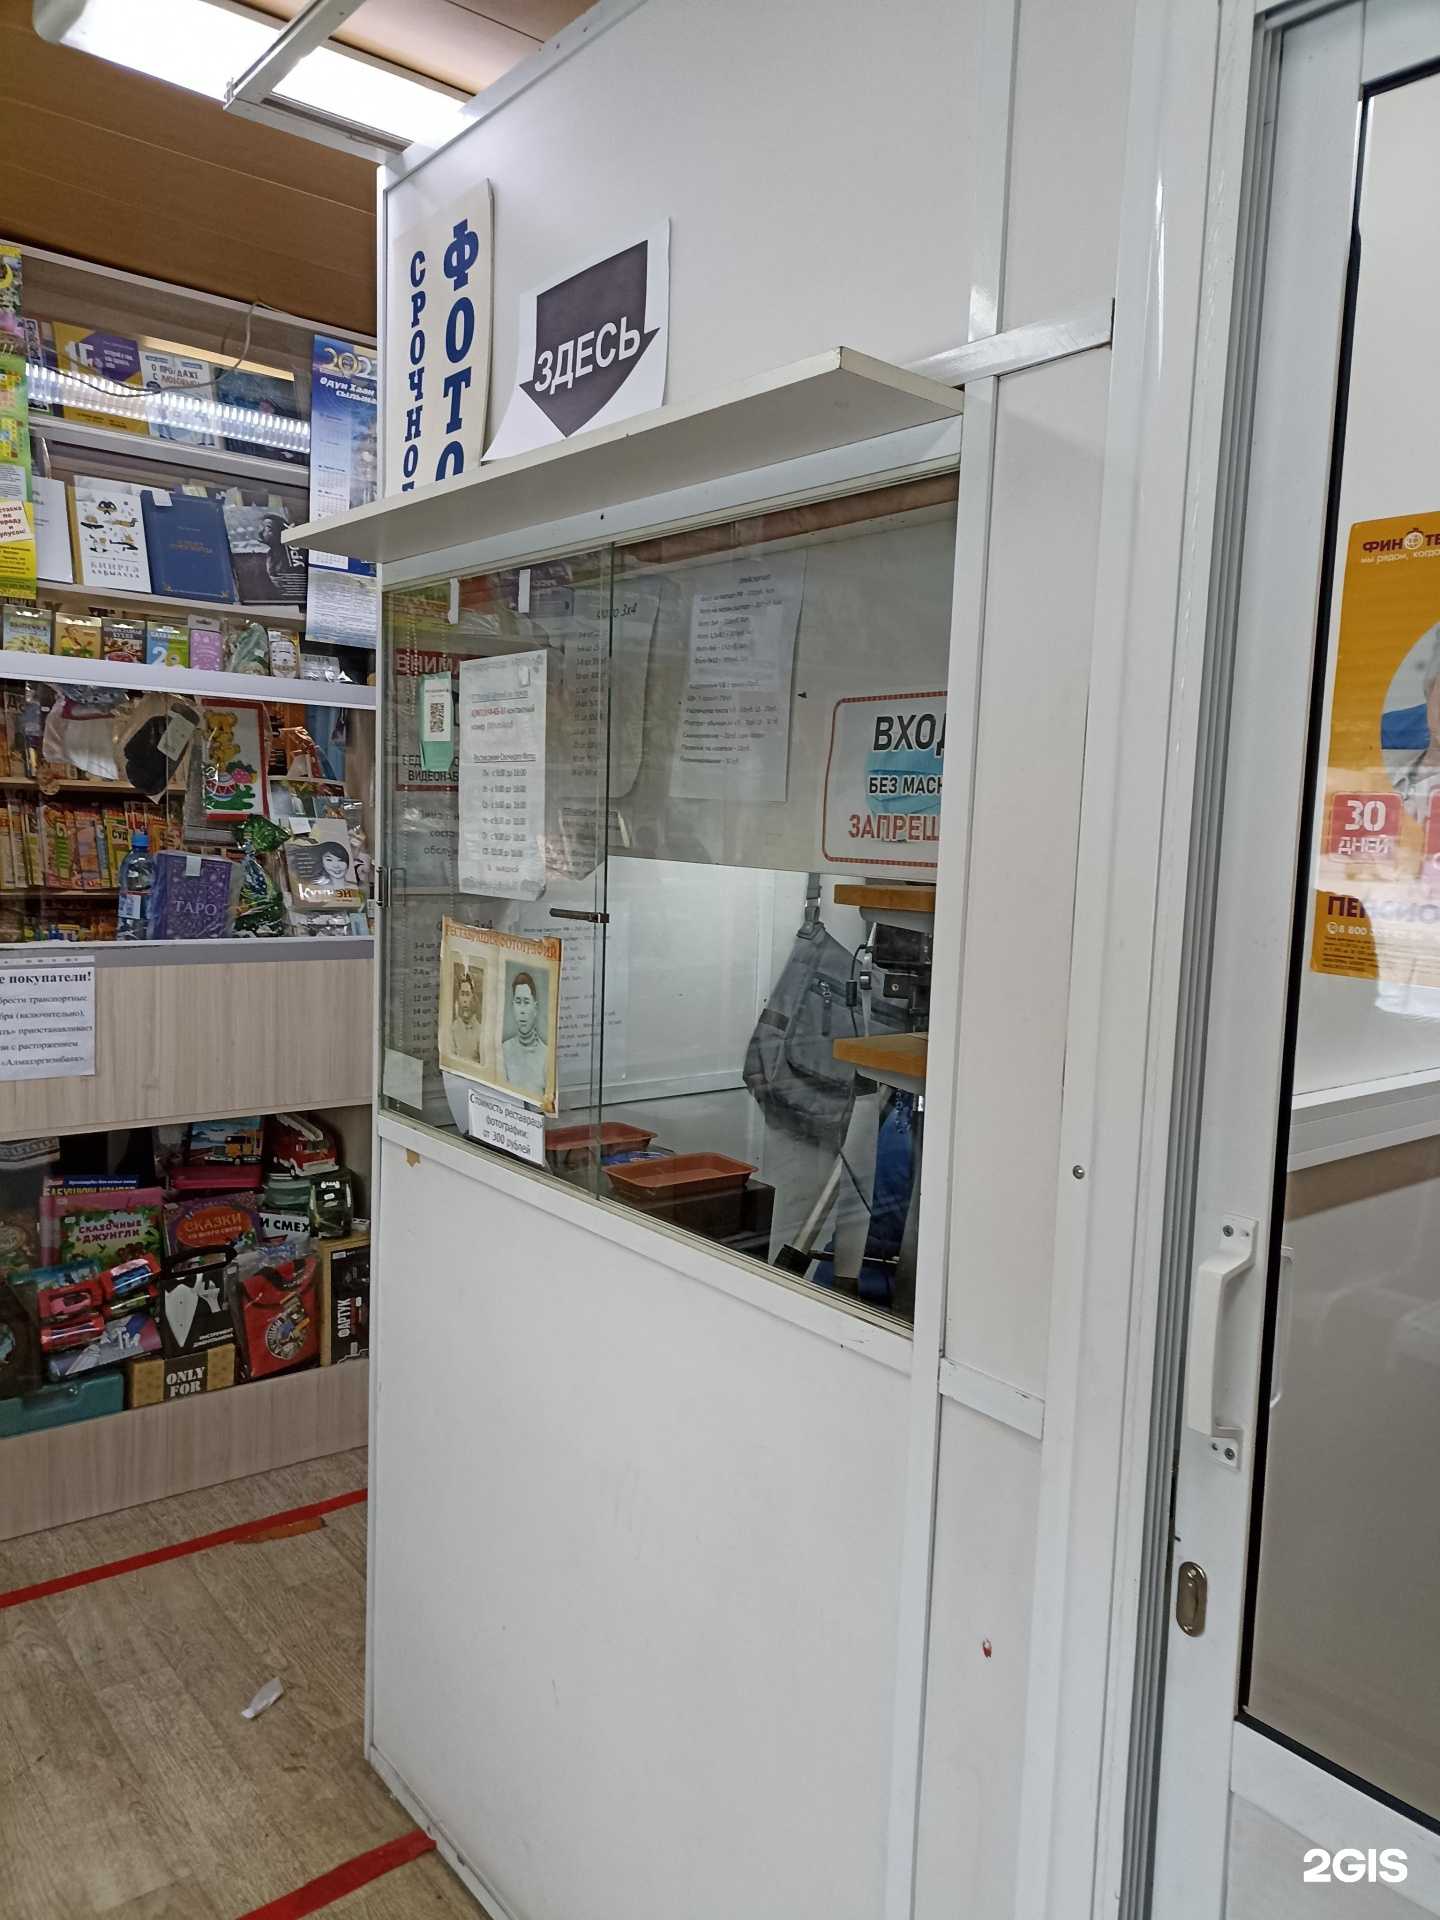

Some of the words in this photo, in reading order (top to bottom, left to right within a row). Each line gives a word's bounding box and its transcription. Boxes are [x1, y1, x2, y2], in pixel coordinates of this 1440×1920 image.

[534, 316, 641, 395] ЗДЕСЬ
[869, 776, 898, 794] БЕЗ
[1344, 799, 1387, 832] 30
[1338, 833, 1395, 855] ДНЕЙ
[174, 899, 217, 916] ТАРО
[10, 971, 92, 986] покупатели!
[470, 1093, 504, 1114] Стоимость
[492, 1131, 505, 1144] 300
[507, 1140, 531, 1154] рублей
[79, 1218, 142, 1234] СКАЗОЧНЫЕ
[184, 1212, 242, 1232] СКАЗКИ
[273, 1219, 312, 1233] СМЕХ
[82, 1229, 140, 1244] ДЖУНГЛИ
[166, 1366, 206, 1385] ONLY
[169, 1380, 202, 1398] FOR
